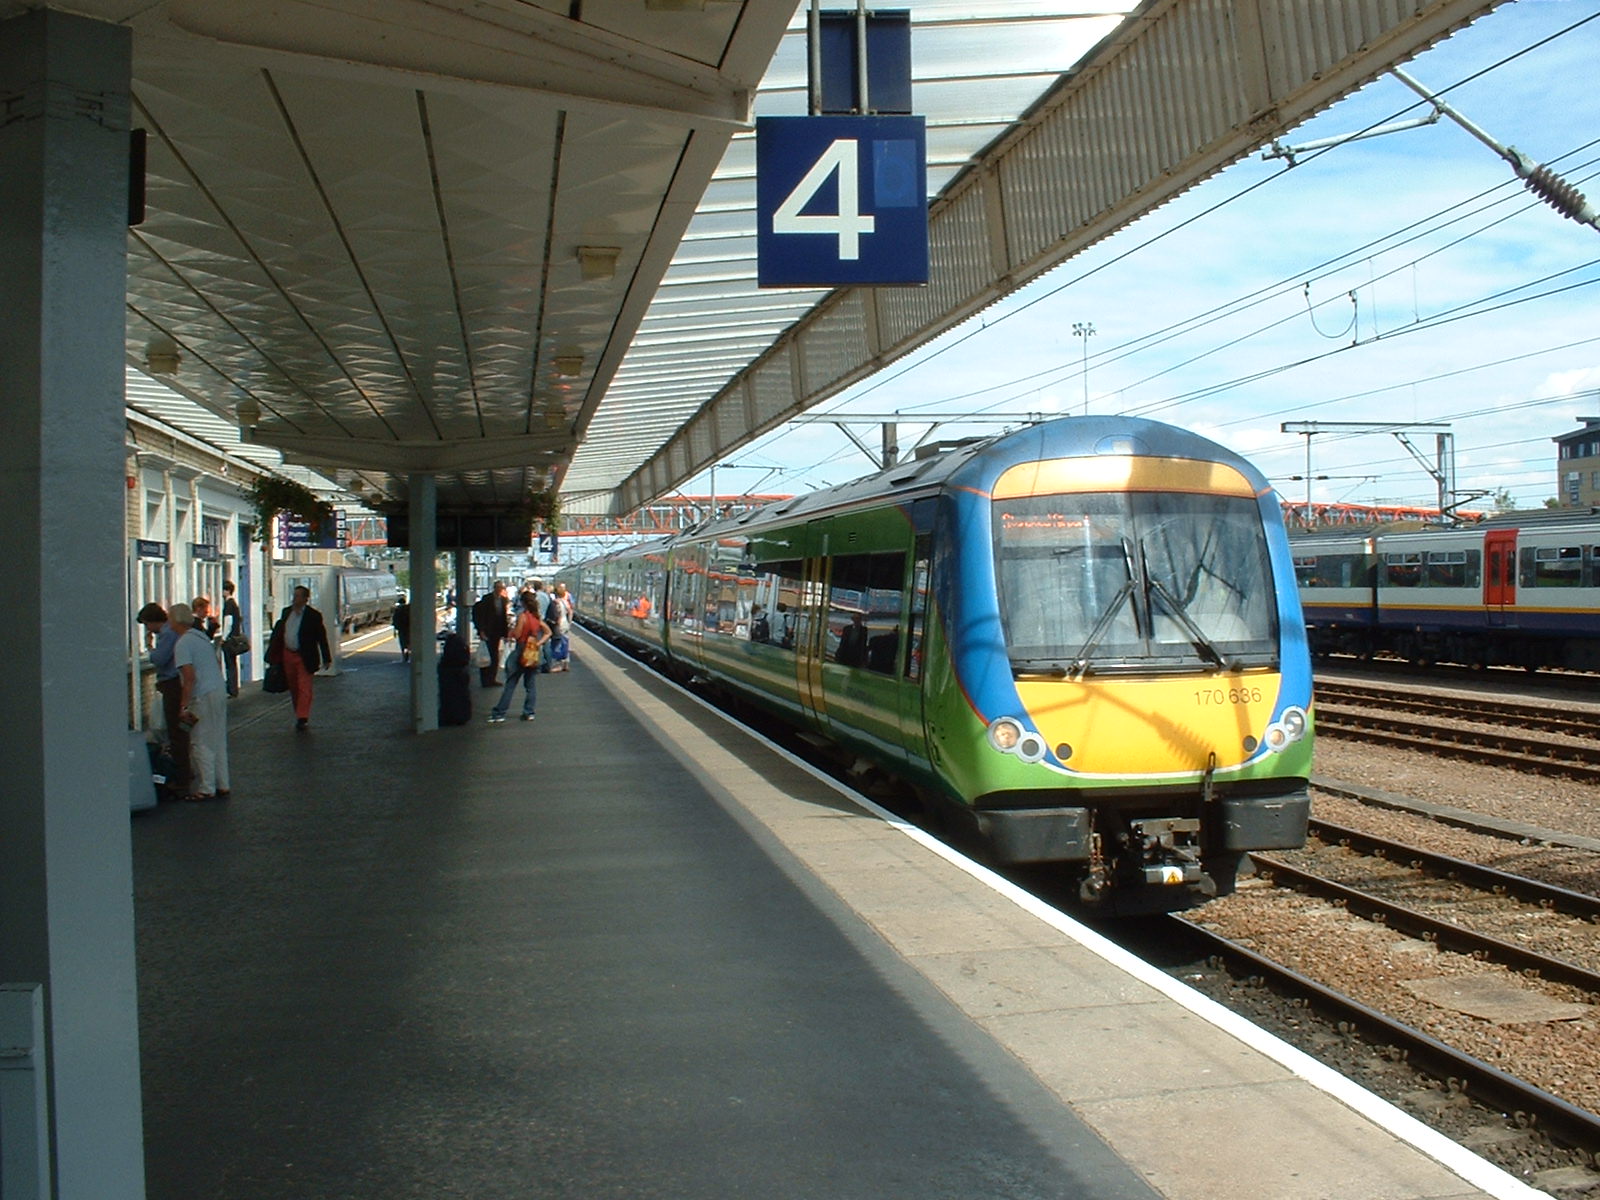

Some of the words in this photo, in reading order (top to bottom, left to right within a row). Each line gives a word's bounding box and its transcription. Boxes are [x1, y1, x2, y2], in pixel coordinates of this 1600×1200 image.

[773, 139, 875, 261] 4
[541, 535, 554, 551] 4
[1194, 689, 1225, 705] 170
[1228, 687, 1262, 704] 636
